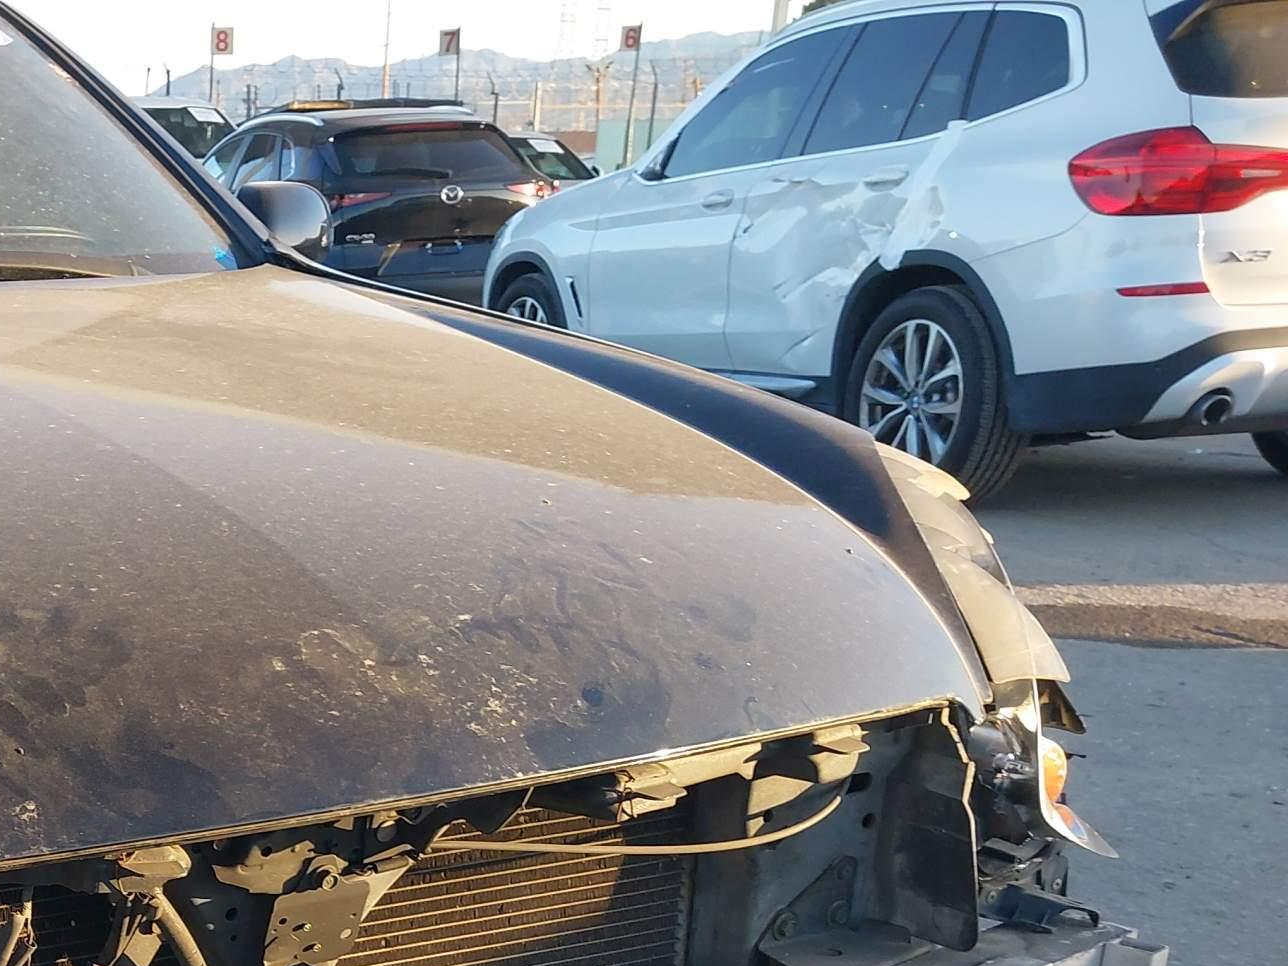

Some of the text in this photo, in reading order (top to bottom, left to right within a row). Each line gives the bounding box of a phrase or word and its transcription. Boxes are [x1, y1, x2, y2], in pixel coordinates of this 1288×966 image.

[216, 30, 228, 51] 8
[444, 31, 457, 52] 7
[625, 28, 637, 49] 6
